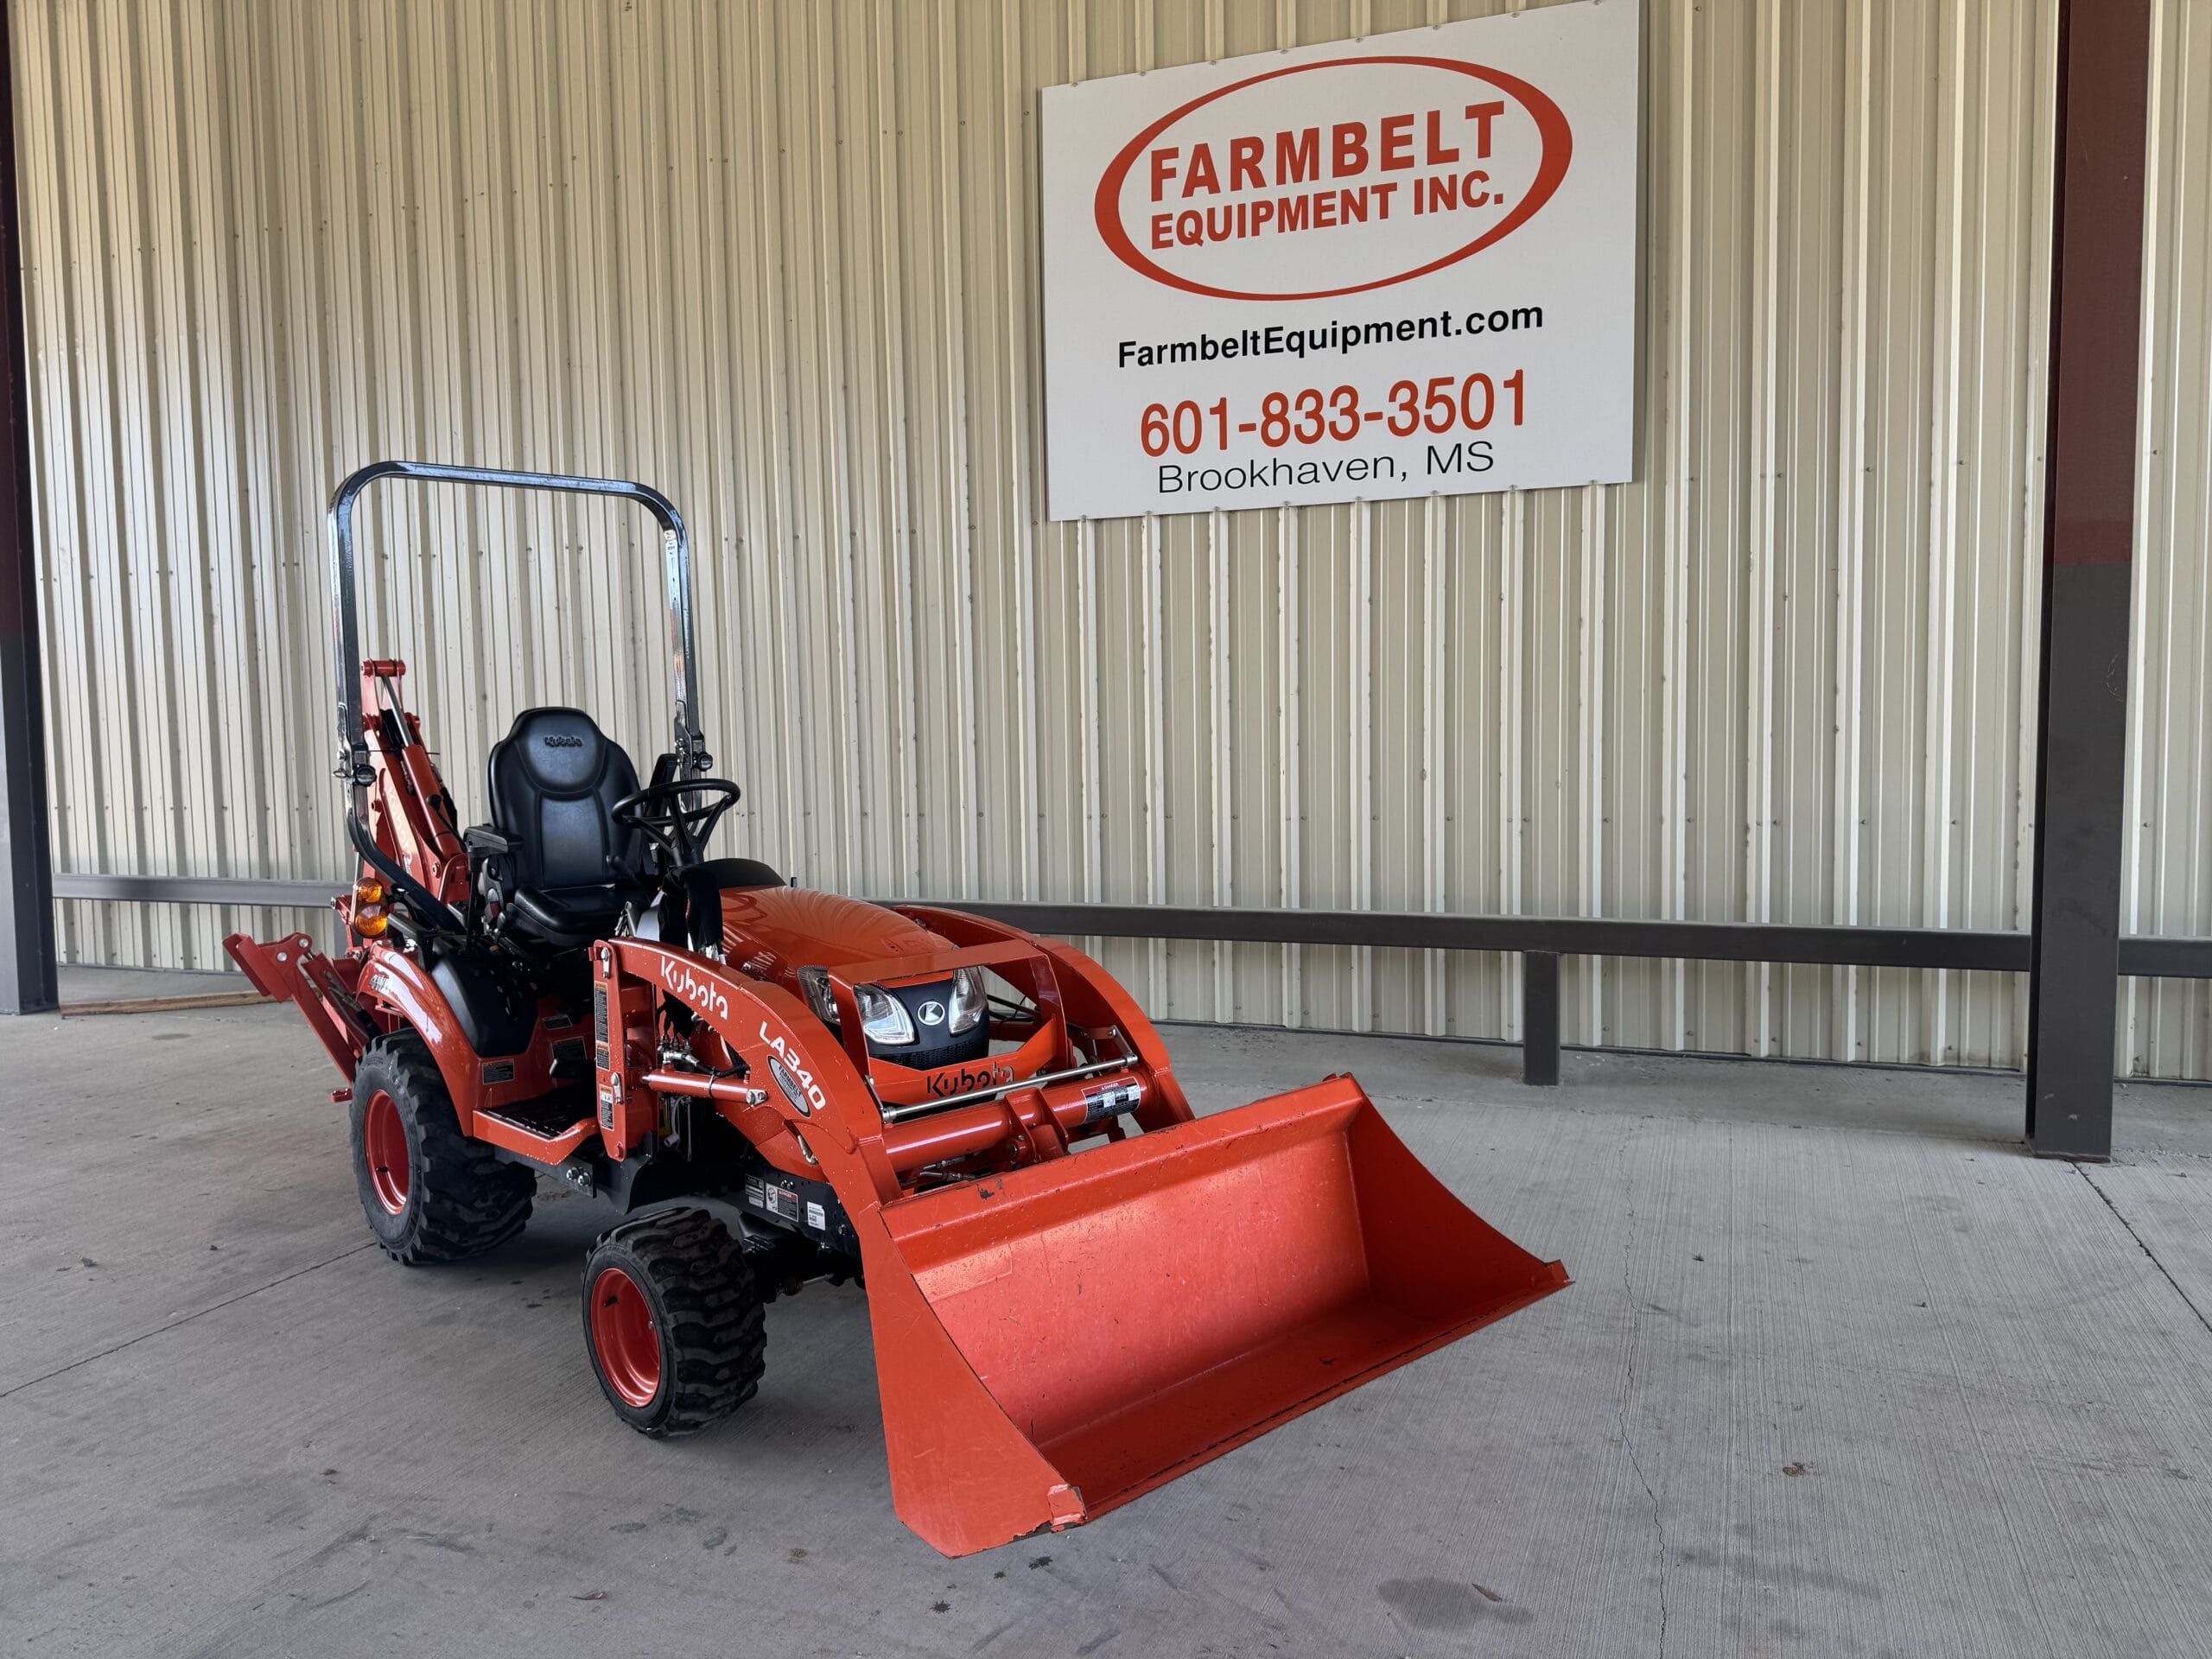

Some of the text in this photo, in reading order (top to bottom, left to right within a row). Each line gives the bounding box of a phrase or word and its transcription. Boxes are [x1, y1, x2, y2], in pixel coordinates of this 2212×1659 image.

[1151, 101, 1504, 202] FARMBELT
[1151, 170, 1504, 250] EQUIPMENT INC.
[1119, 306, 1543, 368] FarmbeltEquipment.com
[1141, 369, 1523, 457] 601-833-3501
[1159, 441, 1494, 493] Brookhaven, MS
[660, 955, 728, 1020] Kubota
[759, 1020, 826, 1110] LA340
[926, 1061, 1014, 1097] Kubota
